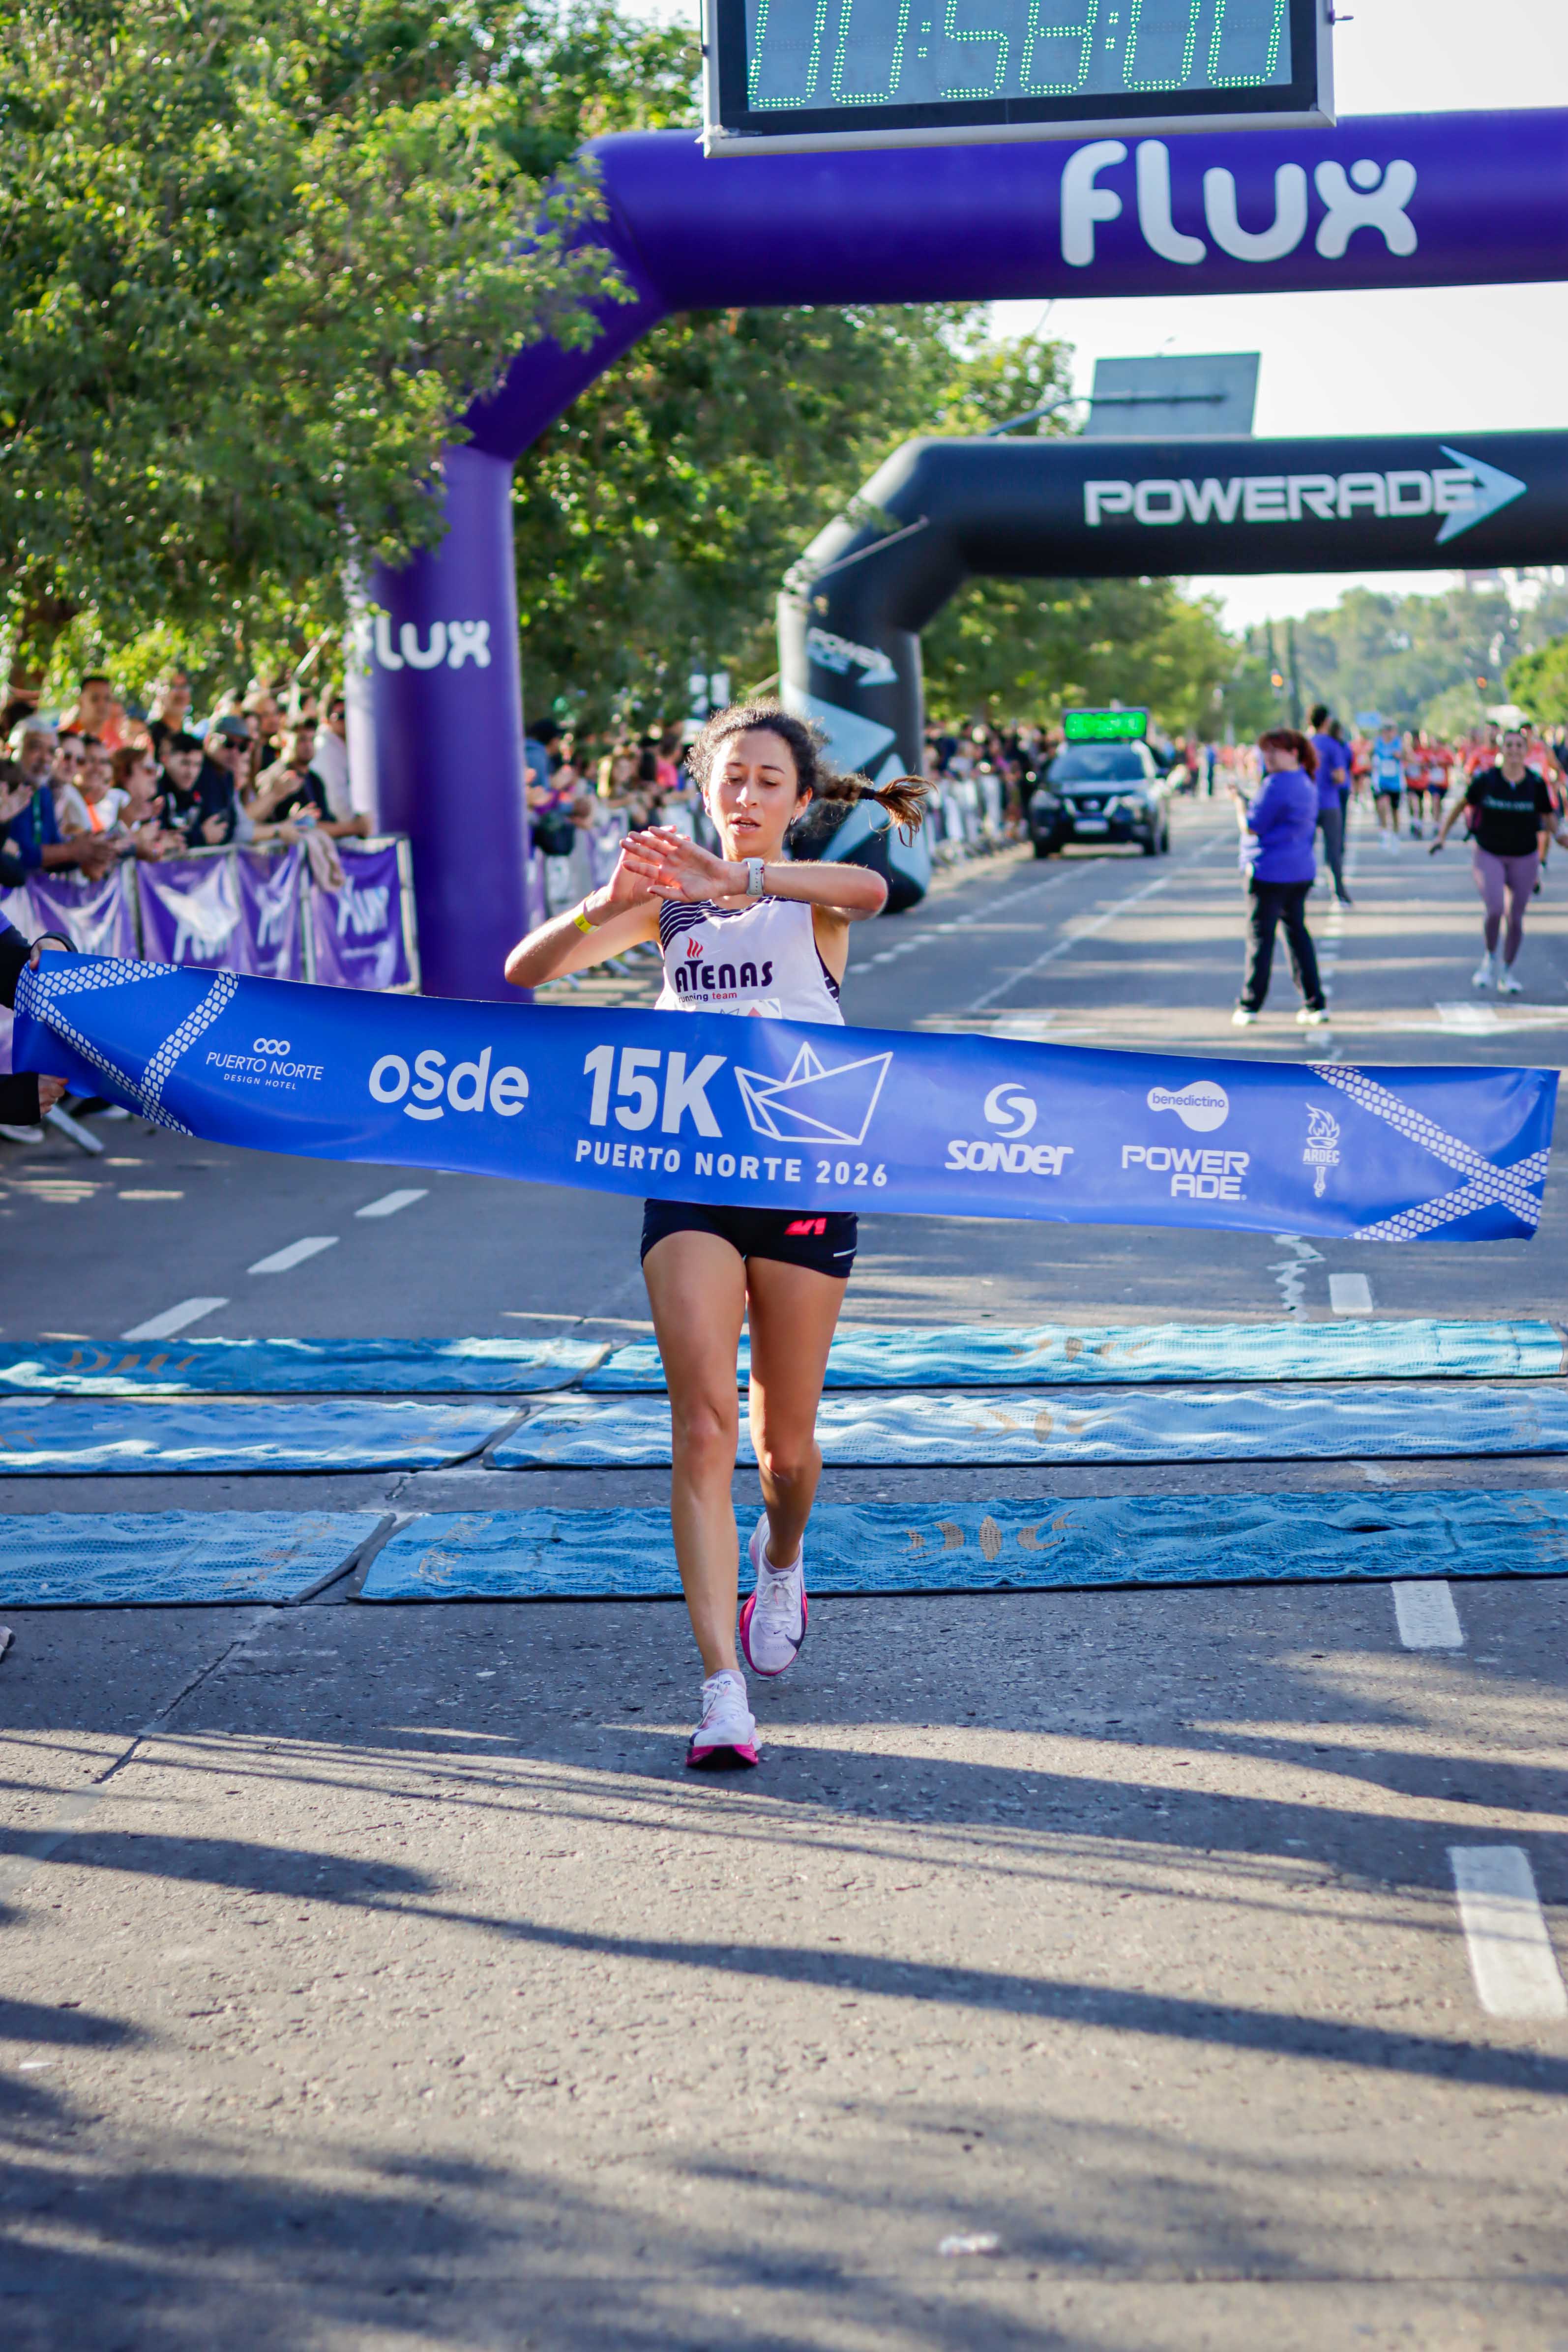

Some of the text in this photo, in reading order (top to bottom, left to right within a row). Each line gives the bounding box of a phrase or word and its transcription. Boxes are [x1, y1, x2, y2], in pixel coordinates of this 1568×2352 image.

[1084, 468, 1476, 527] POWERADE
[675, 960, 773, 993] ATENAS
[679, 993, 709, 1003] running
[206, 1052, 324, 1081] PUERTO NORTE
[224, 1073, 296, 1090] DESIGN HOTEL
[583, 1045, 728, 1138] 15K
[1152, 1092, 1225, 1108] benedictino
[575, 1140, 888, 1187] PUERTO NORTE 2026
[1121, 1145, 1250, 1176] POWER
[1303, 1148, 1340, 1164] ARDEC
